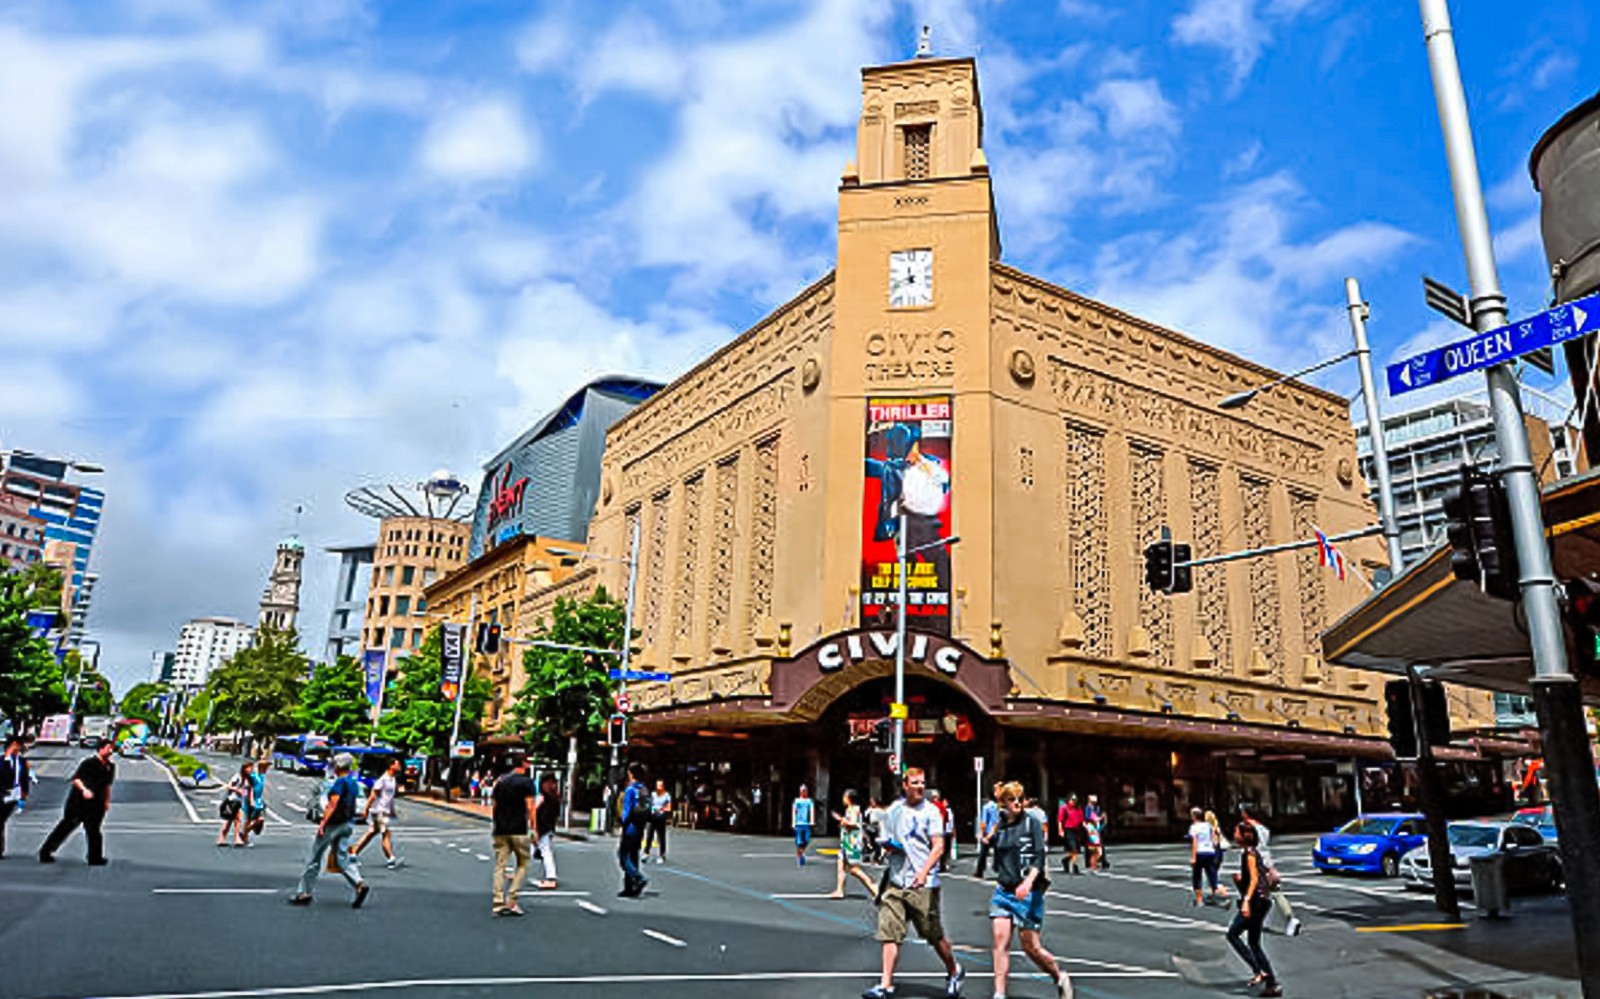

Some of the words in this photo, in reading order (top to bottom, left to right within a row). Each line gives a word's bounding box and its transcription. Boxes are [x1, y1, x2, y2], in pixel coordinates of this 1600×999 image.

[866, 329, 955, 356] CIVIC
[1444, 330, 1512, 371] QUEEN
[864, 360, 954, 380] THEATRE
[869, 403, 950, 422] THRILLER
[817, 631, 963, 673] CIVIC
